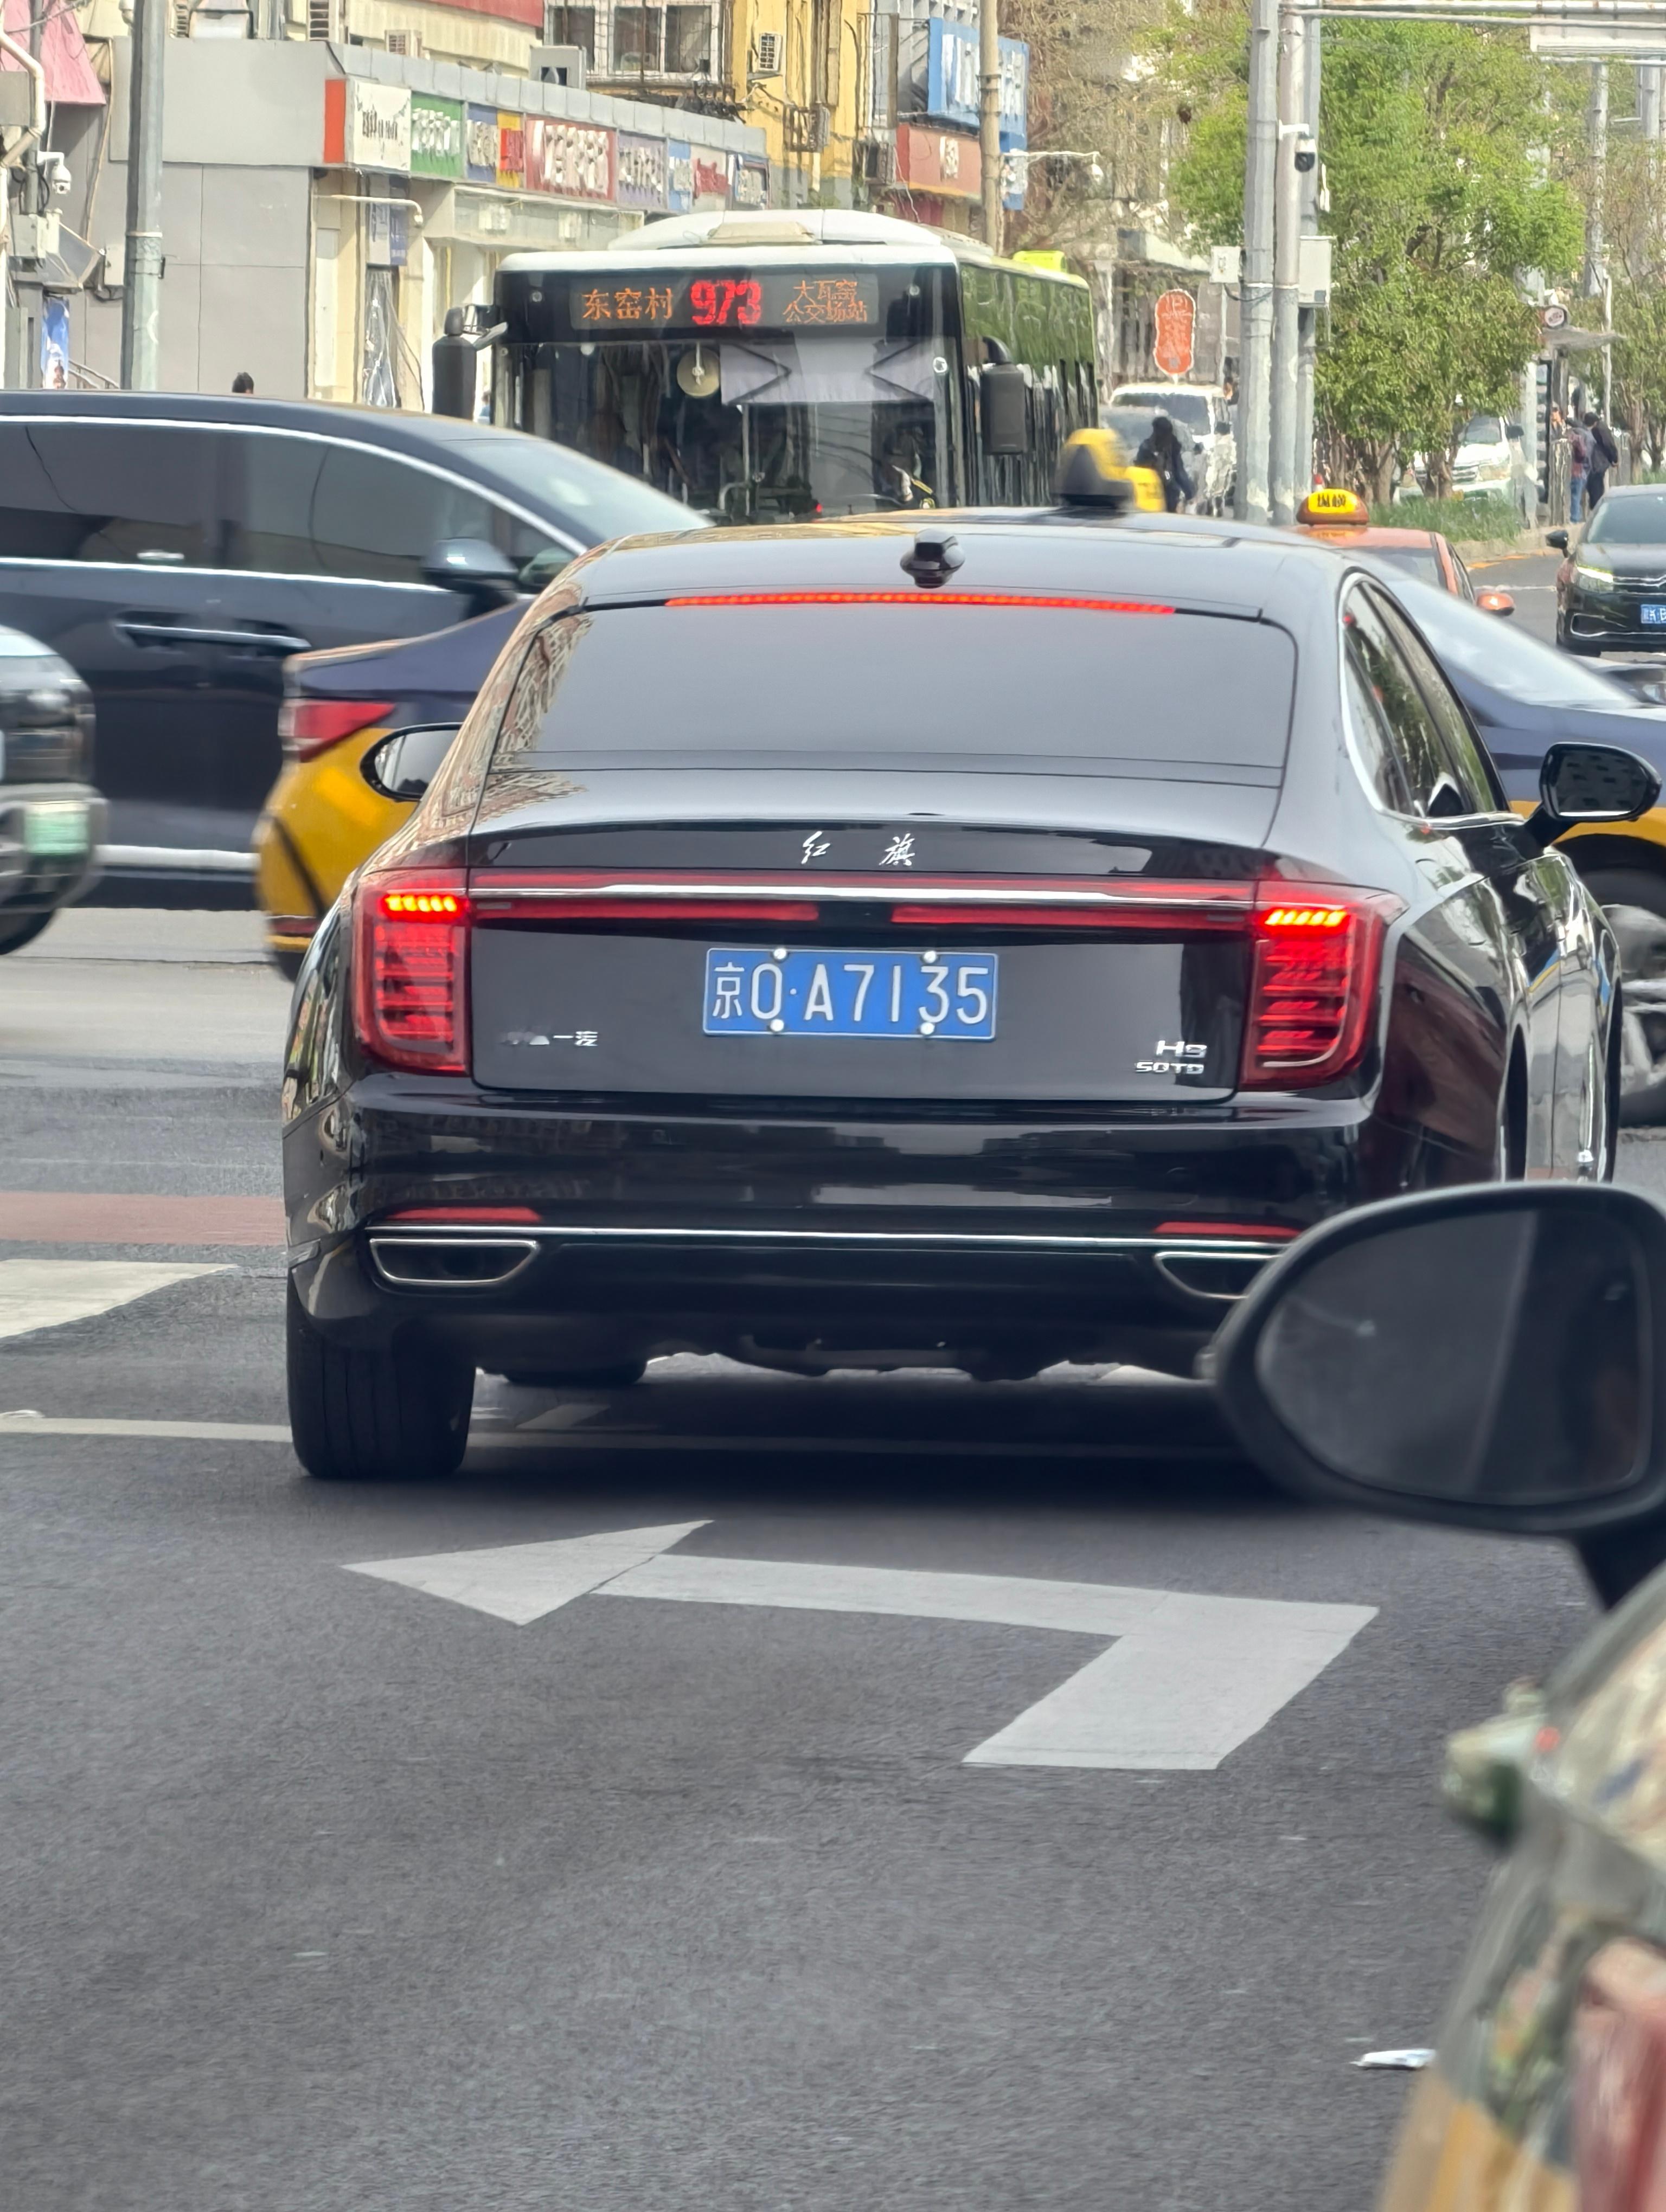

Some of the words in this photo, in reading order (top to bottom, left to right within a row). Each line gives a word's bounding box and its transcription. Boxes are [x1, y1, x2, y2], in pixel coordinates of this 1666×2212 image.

[582, 287, 673, 320] 东窑村
[690, 279, 761, 325] 973
